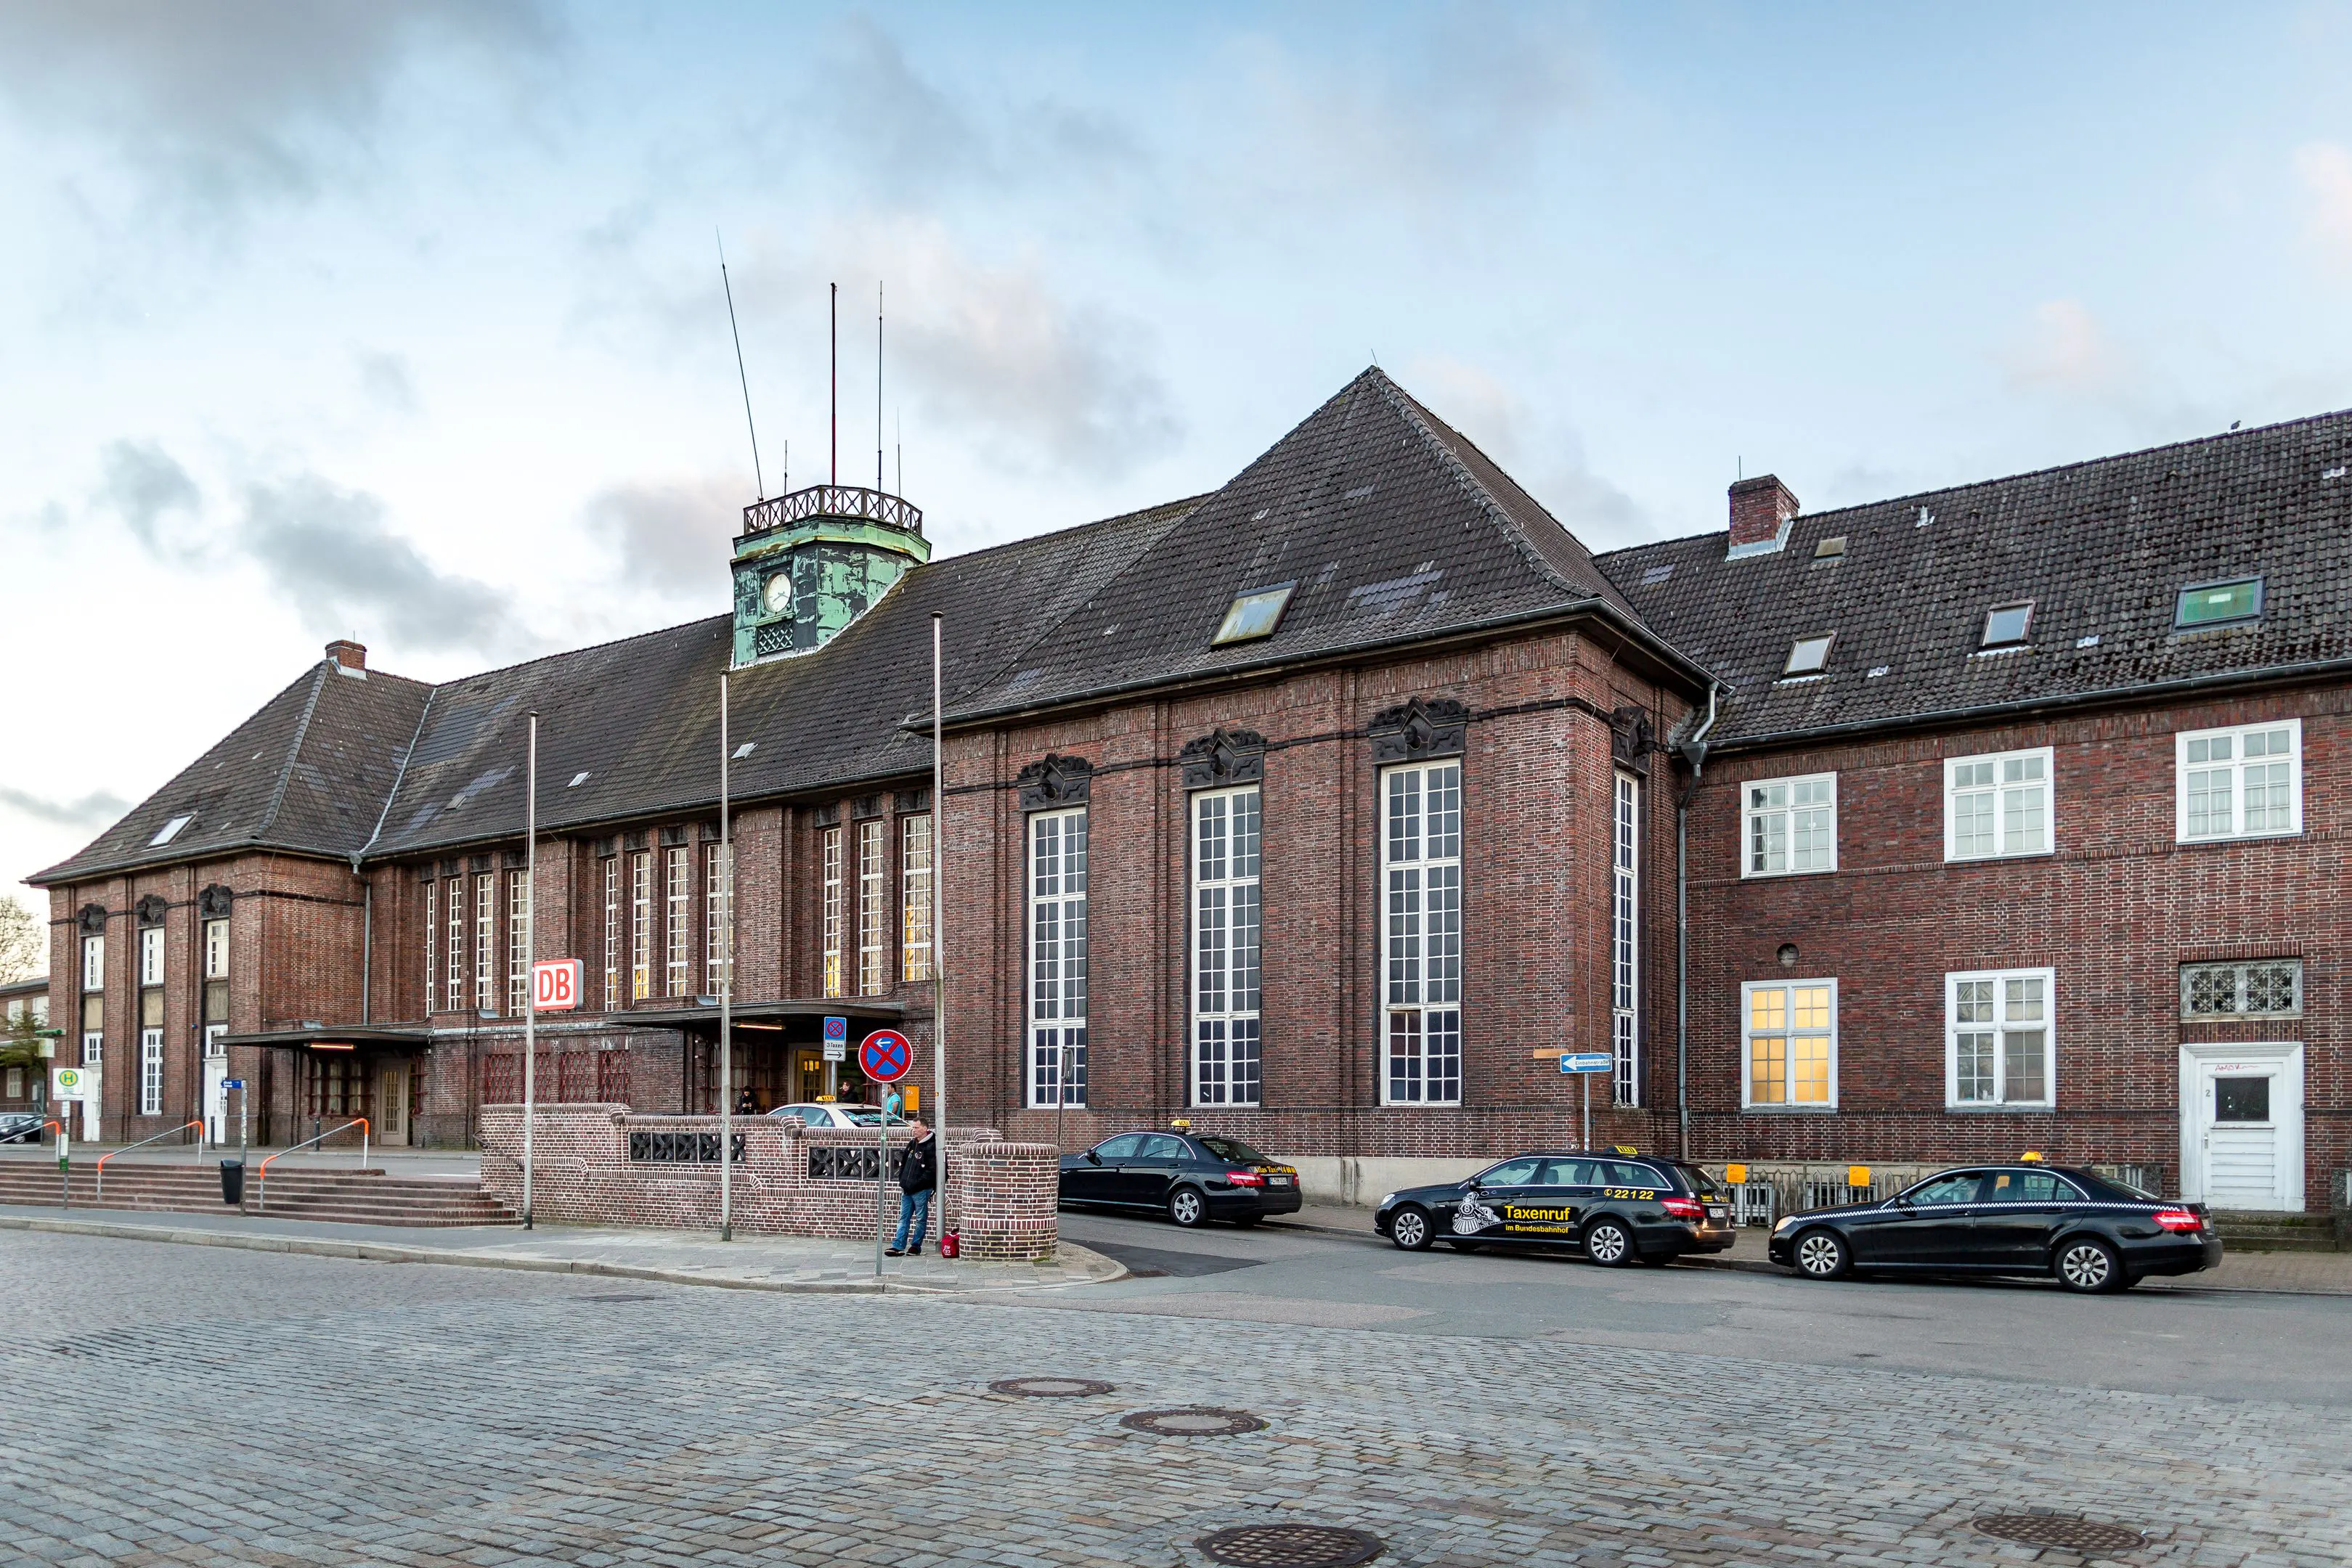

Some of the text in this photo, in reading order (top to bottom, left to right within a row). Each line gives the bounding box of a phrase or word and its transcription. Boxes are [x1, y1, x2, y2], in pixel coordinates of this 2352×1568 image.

[539, 968, 571, 1001] DB
[64, 1074, 73, 1083] H
[1614, 1189, 1654, 1200] 22 1 22
[1504, 1205, 1571, 1220] Taxenruf
[1515, 1225, 1568, 1233] Bundesbahnhof
